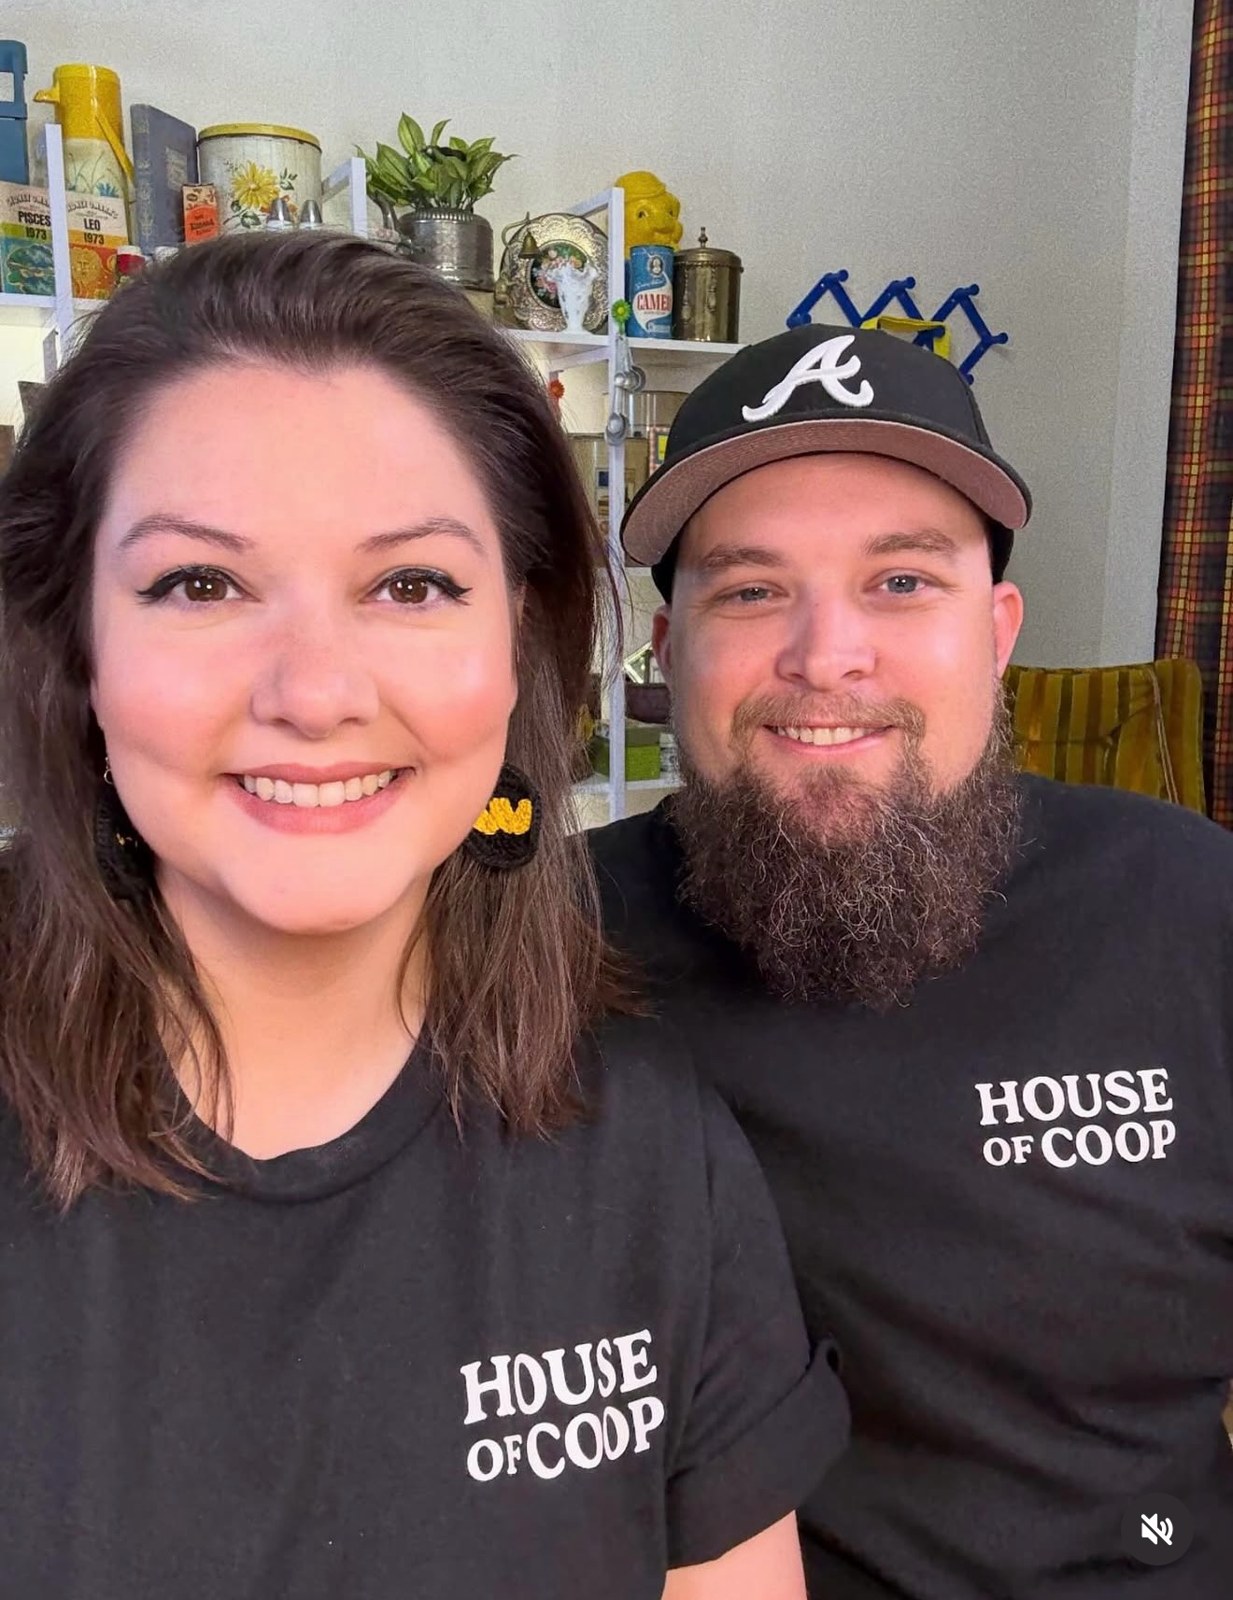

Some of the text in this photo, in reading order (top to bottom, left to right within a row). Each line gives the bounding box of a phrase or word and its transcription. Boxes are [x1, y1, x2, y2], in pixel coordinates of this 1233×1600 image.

[18, 210, 52, 227] PISCES
[25, 226, 47, 240] 1973
[83, 217, 101, 231] LEO
[83, 232, 105, 245] 1973
[741, 334, 875, 422] A
[974, 1067, 1174, 1126] HOUSE
[982, 1119, 1177, 1169] OF COOP
[459, 1328, 658, 1425] HOUSE
[466, 1396, 665, 1482] OF COOP
